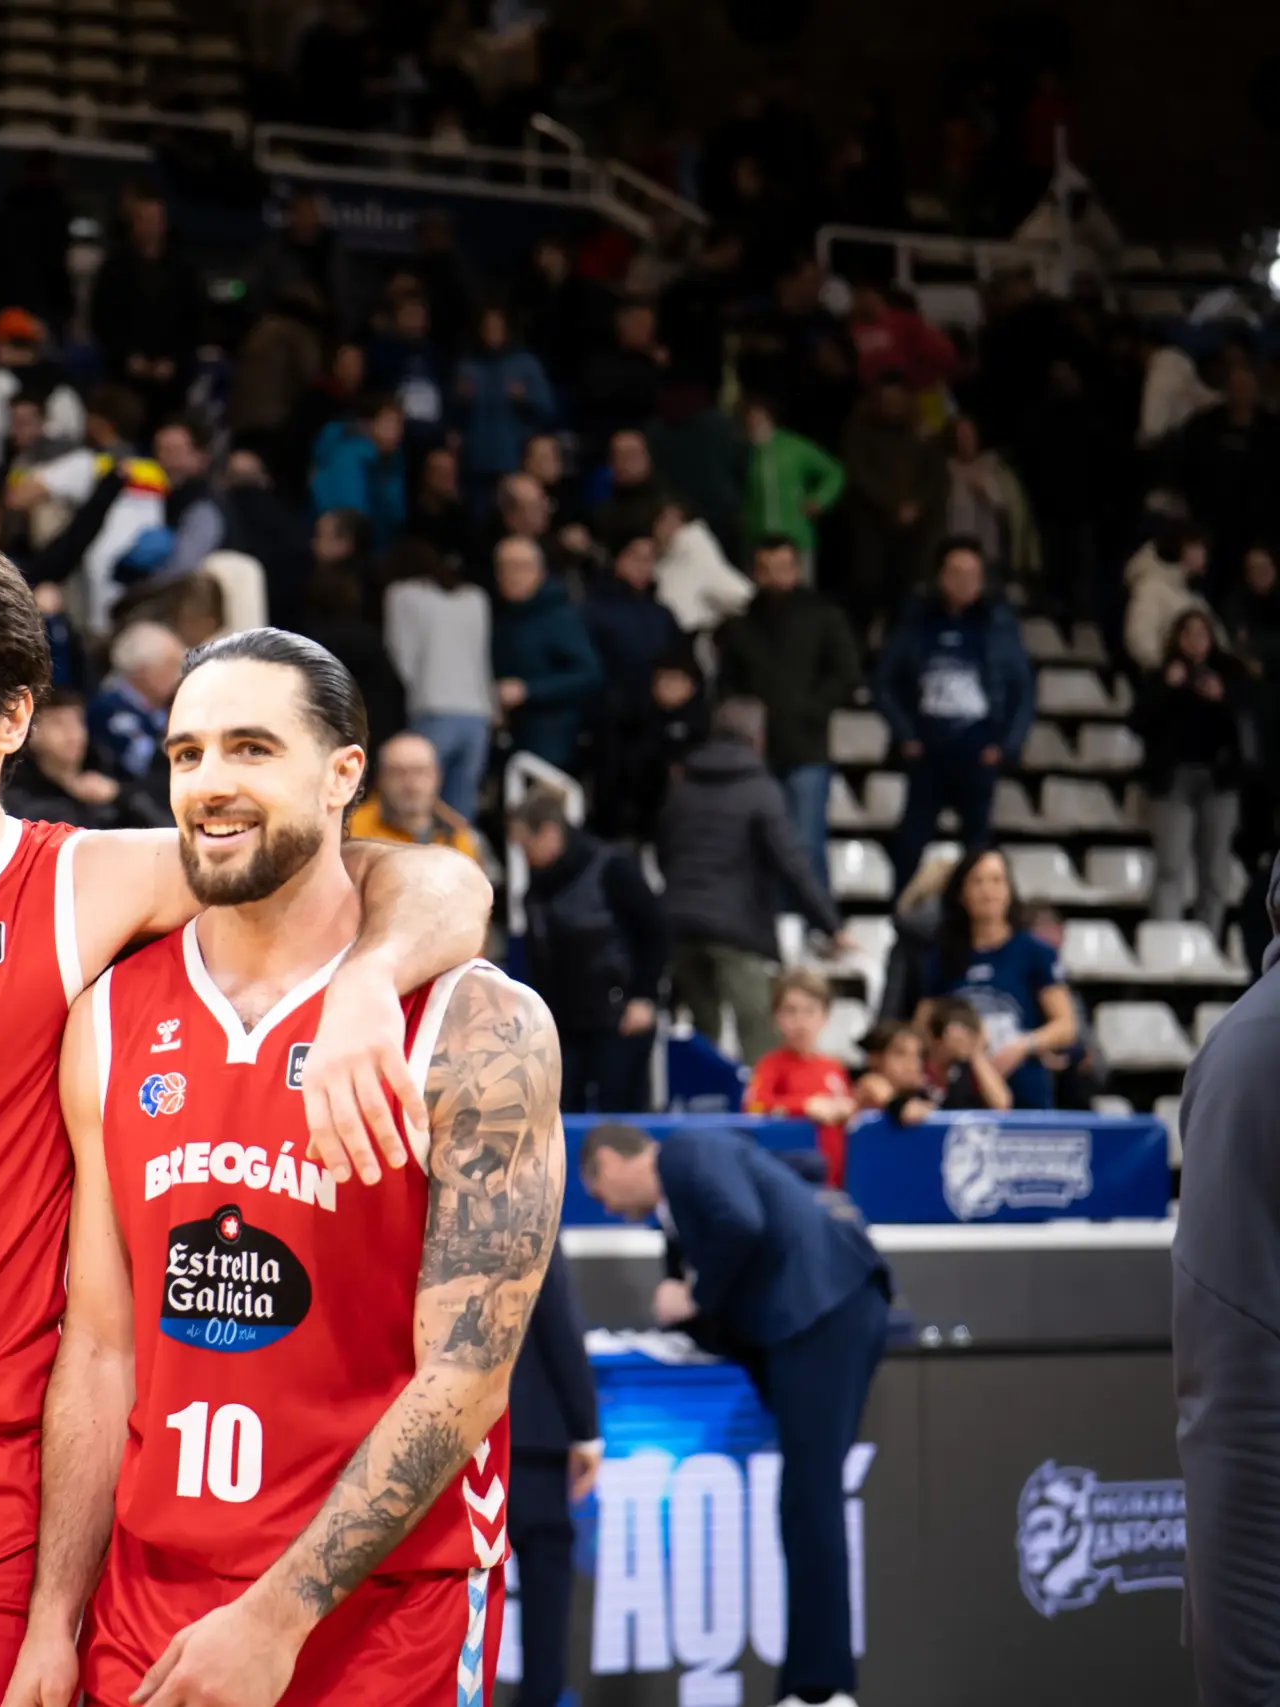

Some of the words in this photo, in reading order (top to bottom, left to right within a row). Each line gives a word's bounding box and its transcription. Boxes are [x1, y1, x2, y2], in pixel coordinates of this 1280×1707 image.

[145, 1141, 336, 1212] BREOGÁN
[166, 1242, 281, 1284] Estrella
[168, 1277, 274, 1318] Galicia
[205, 1317, 238, 1346] 0,0
[166, 1400, 263, 1503] 10
